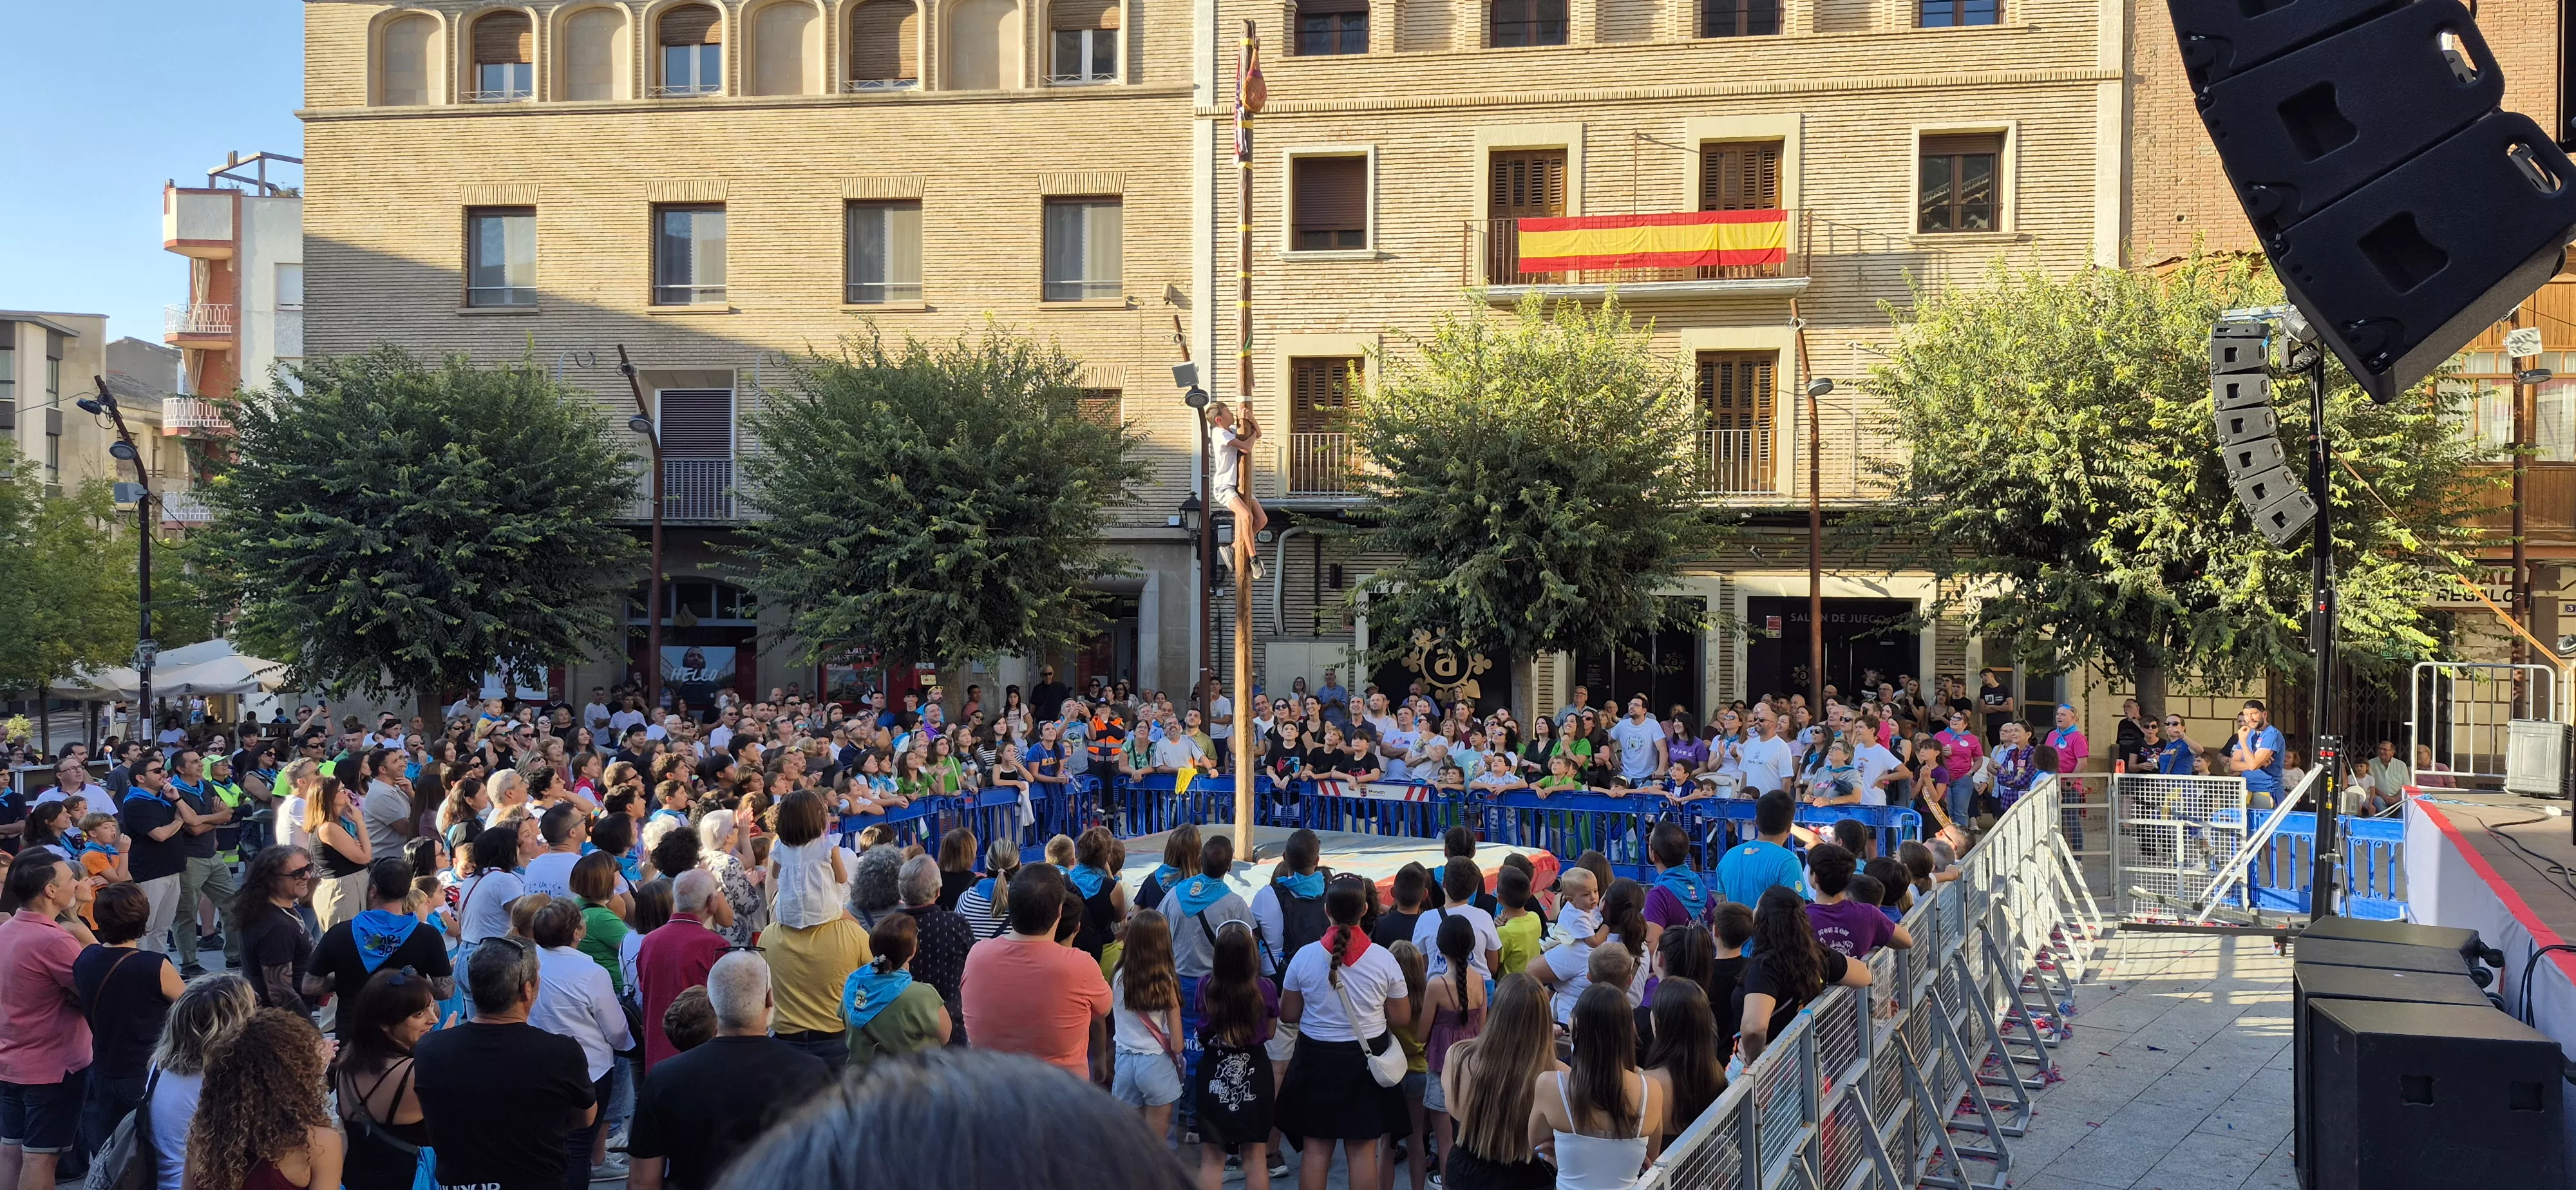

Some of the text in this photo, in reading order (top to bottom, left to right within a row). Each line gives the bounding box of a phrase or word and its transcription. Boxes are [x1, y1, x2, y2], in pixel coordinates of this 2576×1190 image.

[1790, 613, 1828, 623] SALN
[1832, 614, 1846, 623] DE
[670, 666, 719, 681] HELLO
[1219, 1092, 1229, 1103] 2
